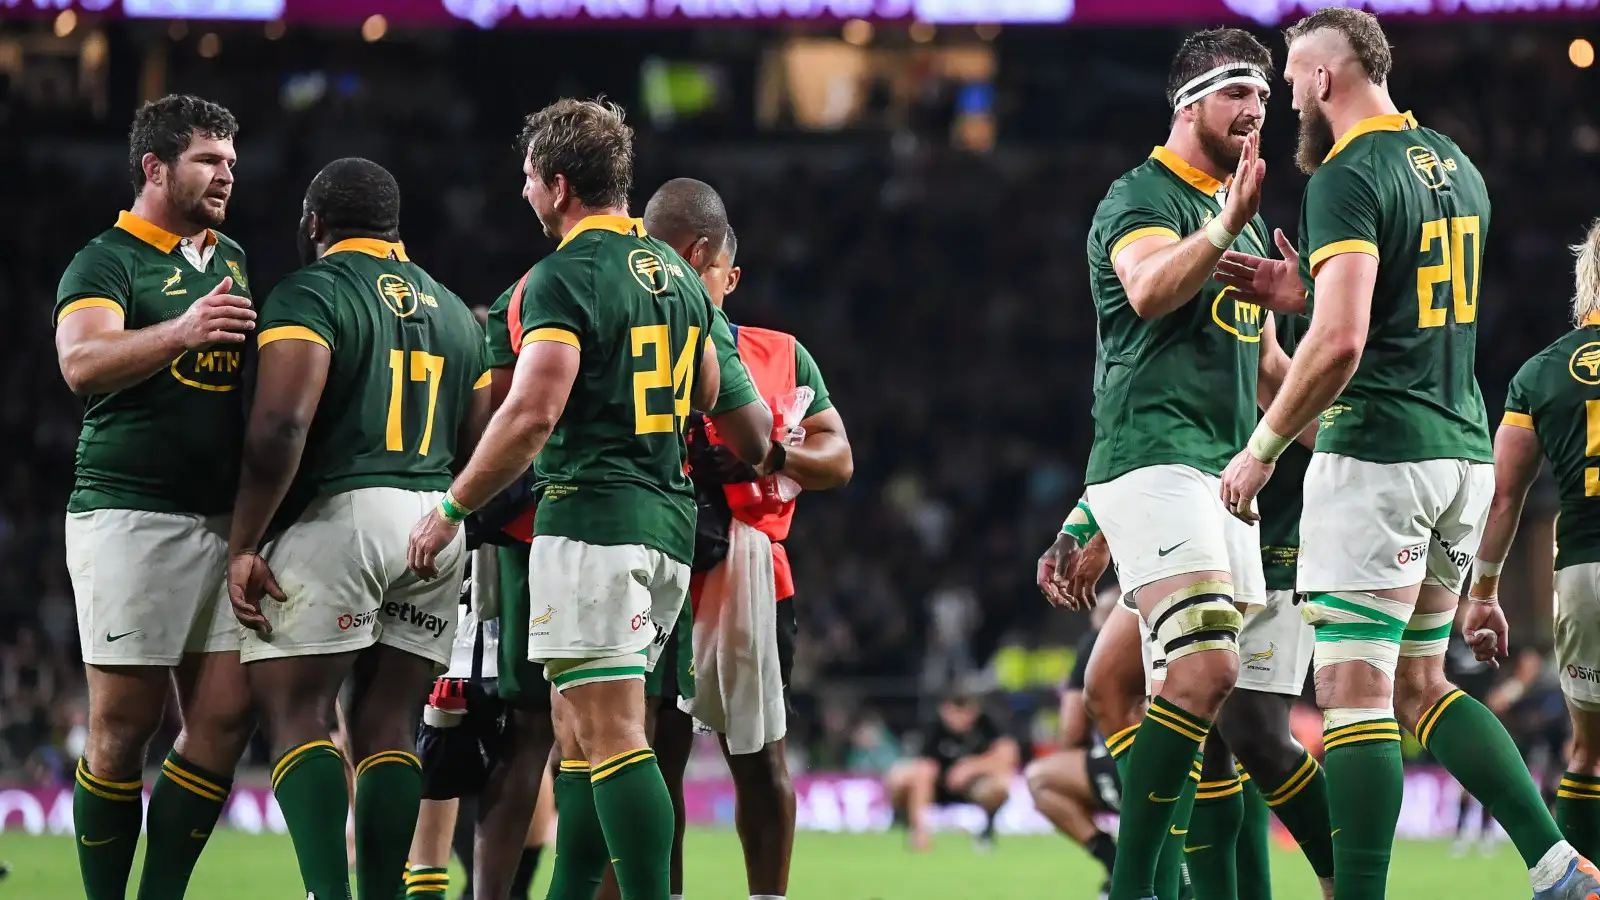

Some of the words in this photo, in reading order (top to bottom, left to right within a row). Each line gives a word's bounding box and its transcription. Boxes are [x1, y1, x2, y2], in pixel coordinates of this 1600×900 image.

[1441, 157, 1458, 171] NB
[1416, 216, 1480, 328] 20
[194, 351, 240, 373] MTN
[631, 324, 700, 435] 24
[386, 348, 445, 456] 17
[379, 601, 449, 639] etway
